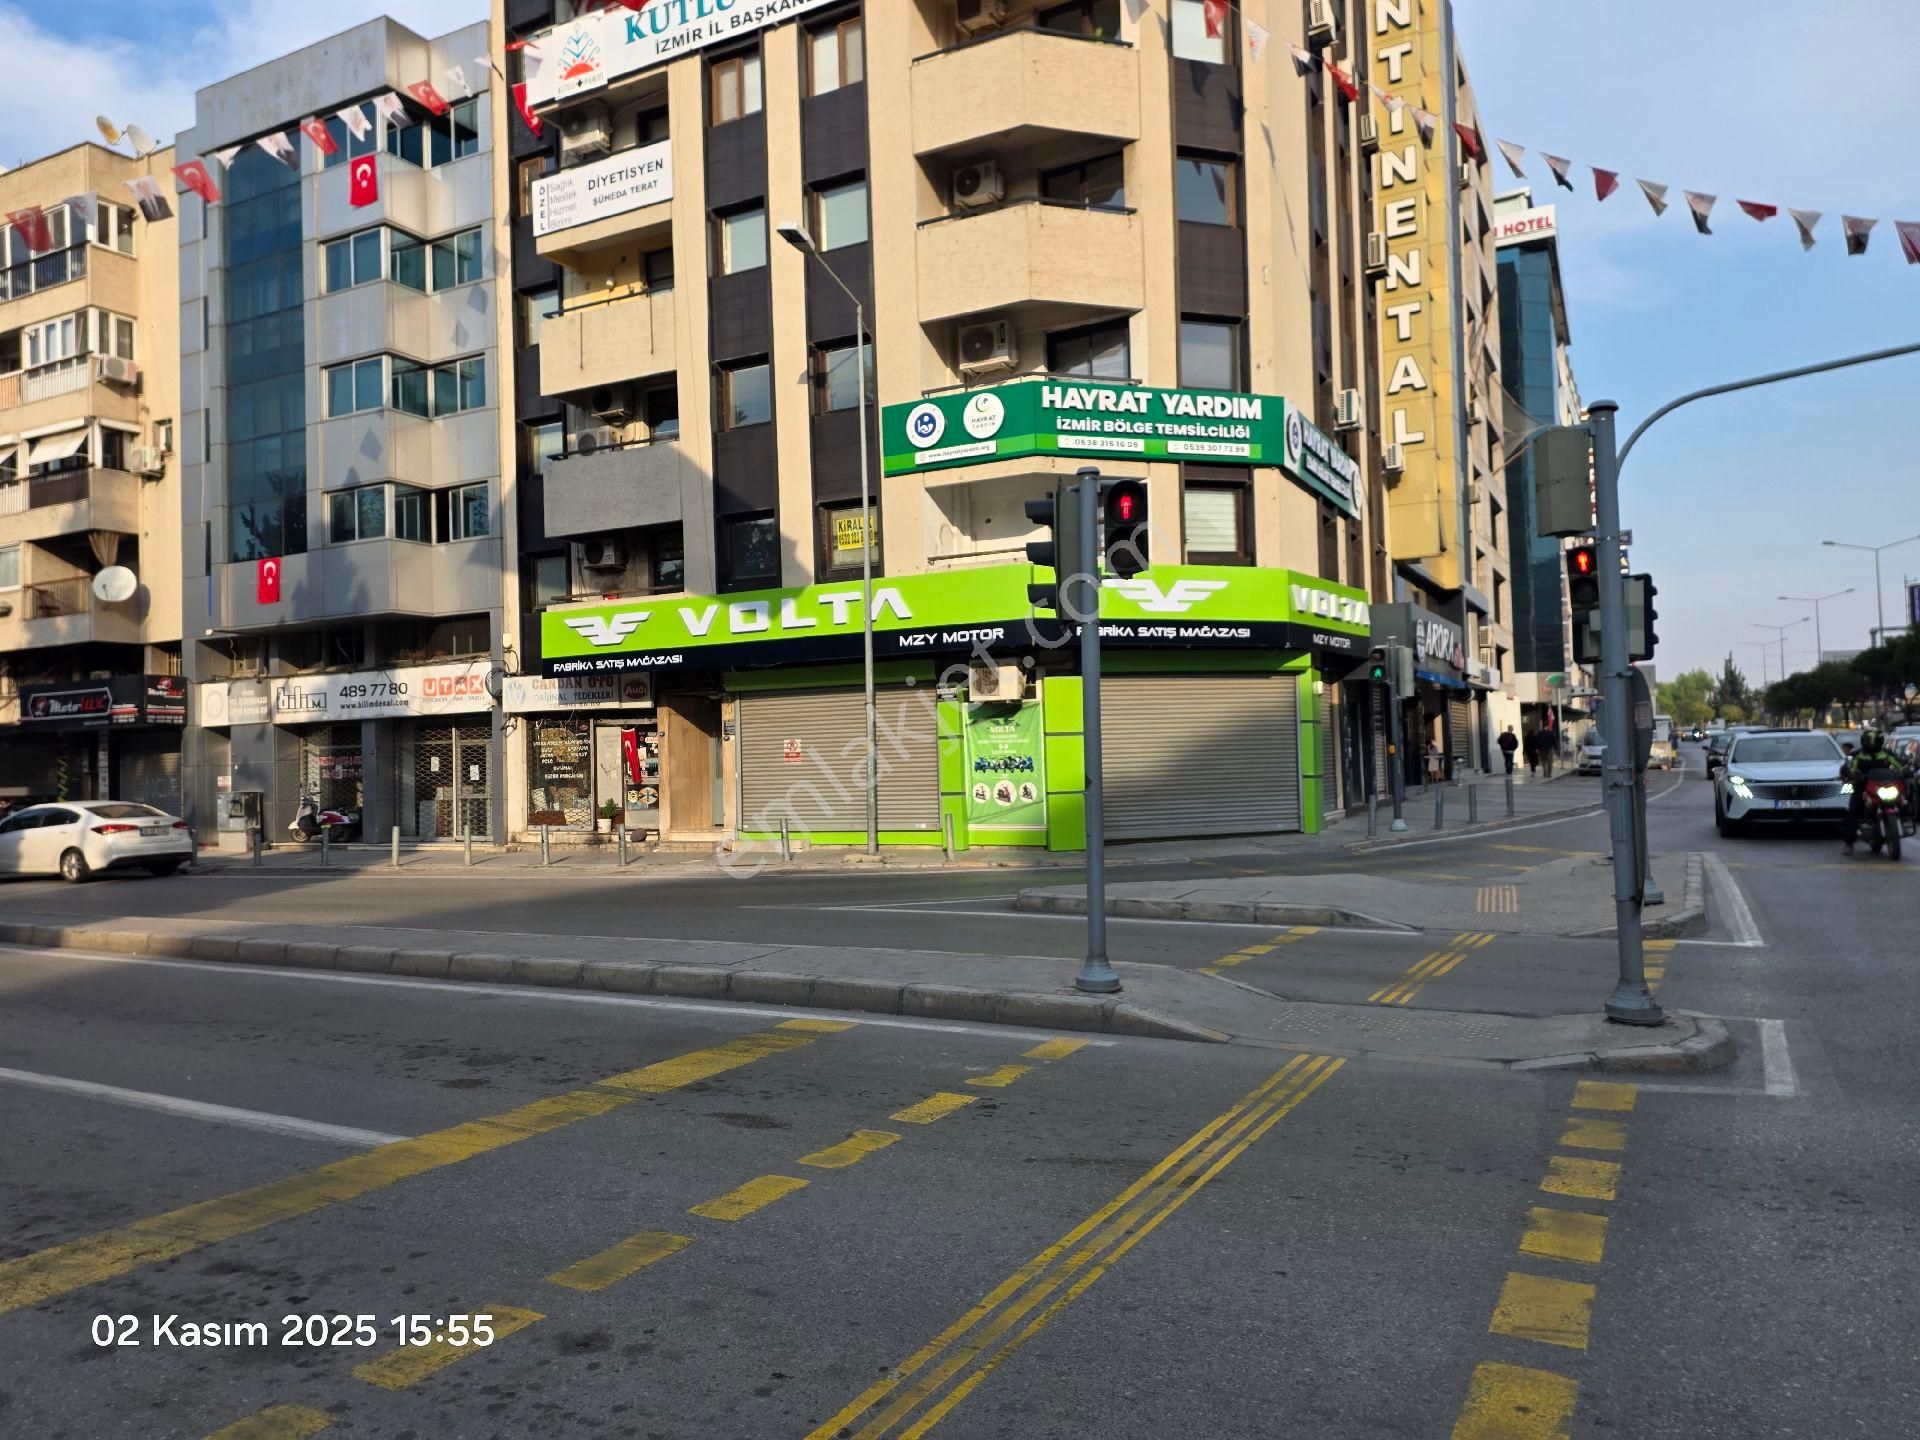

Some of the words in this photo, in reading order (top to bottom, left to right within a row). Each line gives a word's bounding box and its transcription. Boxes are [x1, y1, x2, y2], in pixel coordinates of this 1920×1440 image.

[656, 28, 703, 54] İZMİR
[709, 20, 724, 36] İL
[588, 158, 663, 191] DİYETİSYEN
[630, 180, 659, 194] TERAT
[1504, 216, 1552, 235] HOTEL
[1042, 386, 1152, 413] HAYRAT
[1161, 393, 1262, 420] YARDIM
[1056, 416, 1101, 432] İZMİR
[1103, 419, 1153, 434] BÖLGE
[1155, 423, 1250, 439] TEMSİLCİLİĞİ
[838, 516, 872, 533] KİRALK
[677, 587, 913, 638] VOLTA
[1291, 584, 1371, 625] VOLTA
[899, 634, 938, 646] MZY
[943, 628, 1004, 643] MOTOR
[1076, 624, 1134, 637] FBRİKA
[1138, 626, 1177, 639] SATIŞ
[1179, 625, 1251, 638] MAĞAZASI
[1313, 633, 1329, 645] MZY
[1329, 636, 1351, 648] MOTOR
[553, 659, 594, 673] FABRİKA
[596, 658, 625, 670] SATIŞ
[626, 654, 683, 668] MAĞAZASI
[340, 685, 367, 698] 489
[424, 675, 484, 696] UTAX
[532, 675, 583, 690] CANDAN
[589, 675, 614, 688] OTO
[625, 684, 647, 695] Audi
[573, 688, 614, 701] YEDEKLERİ
